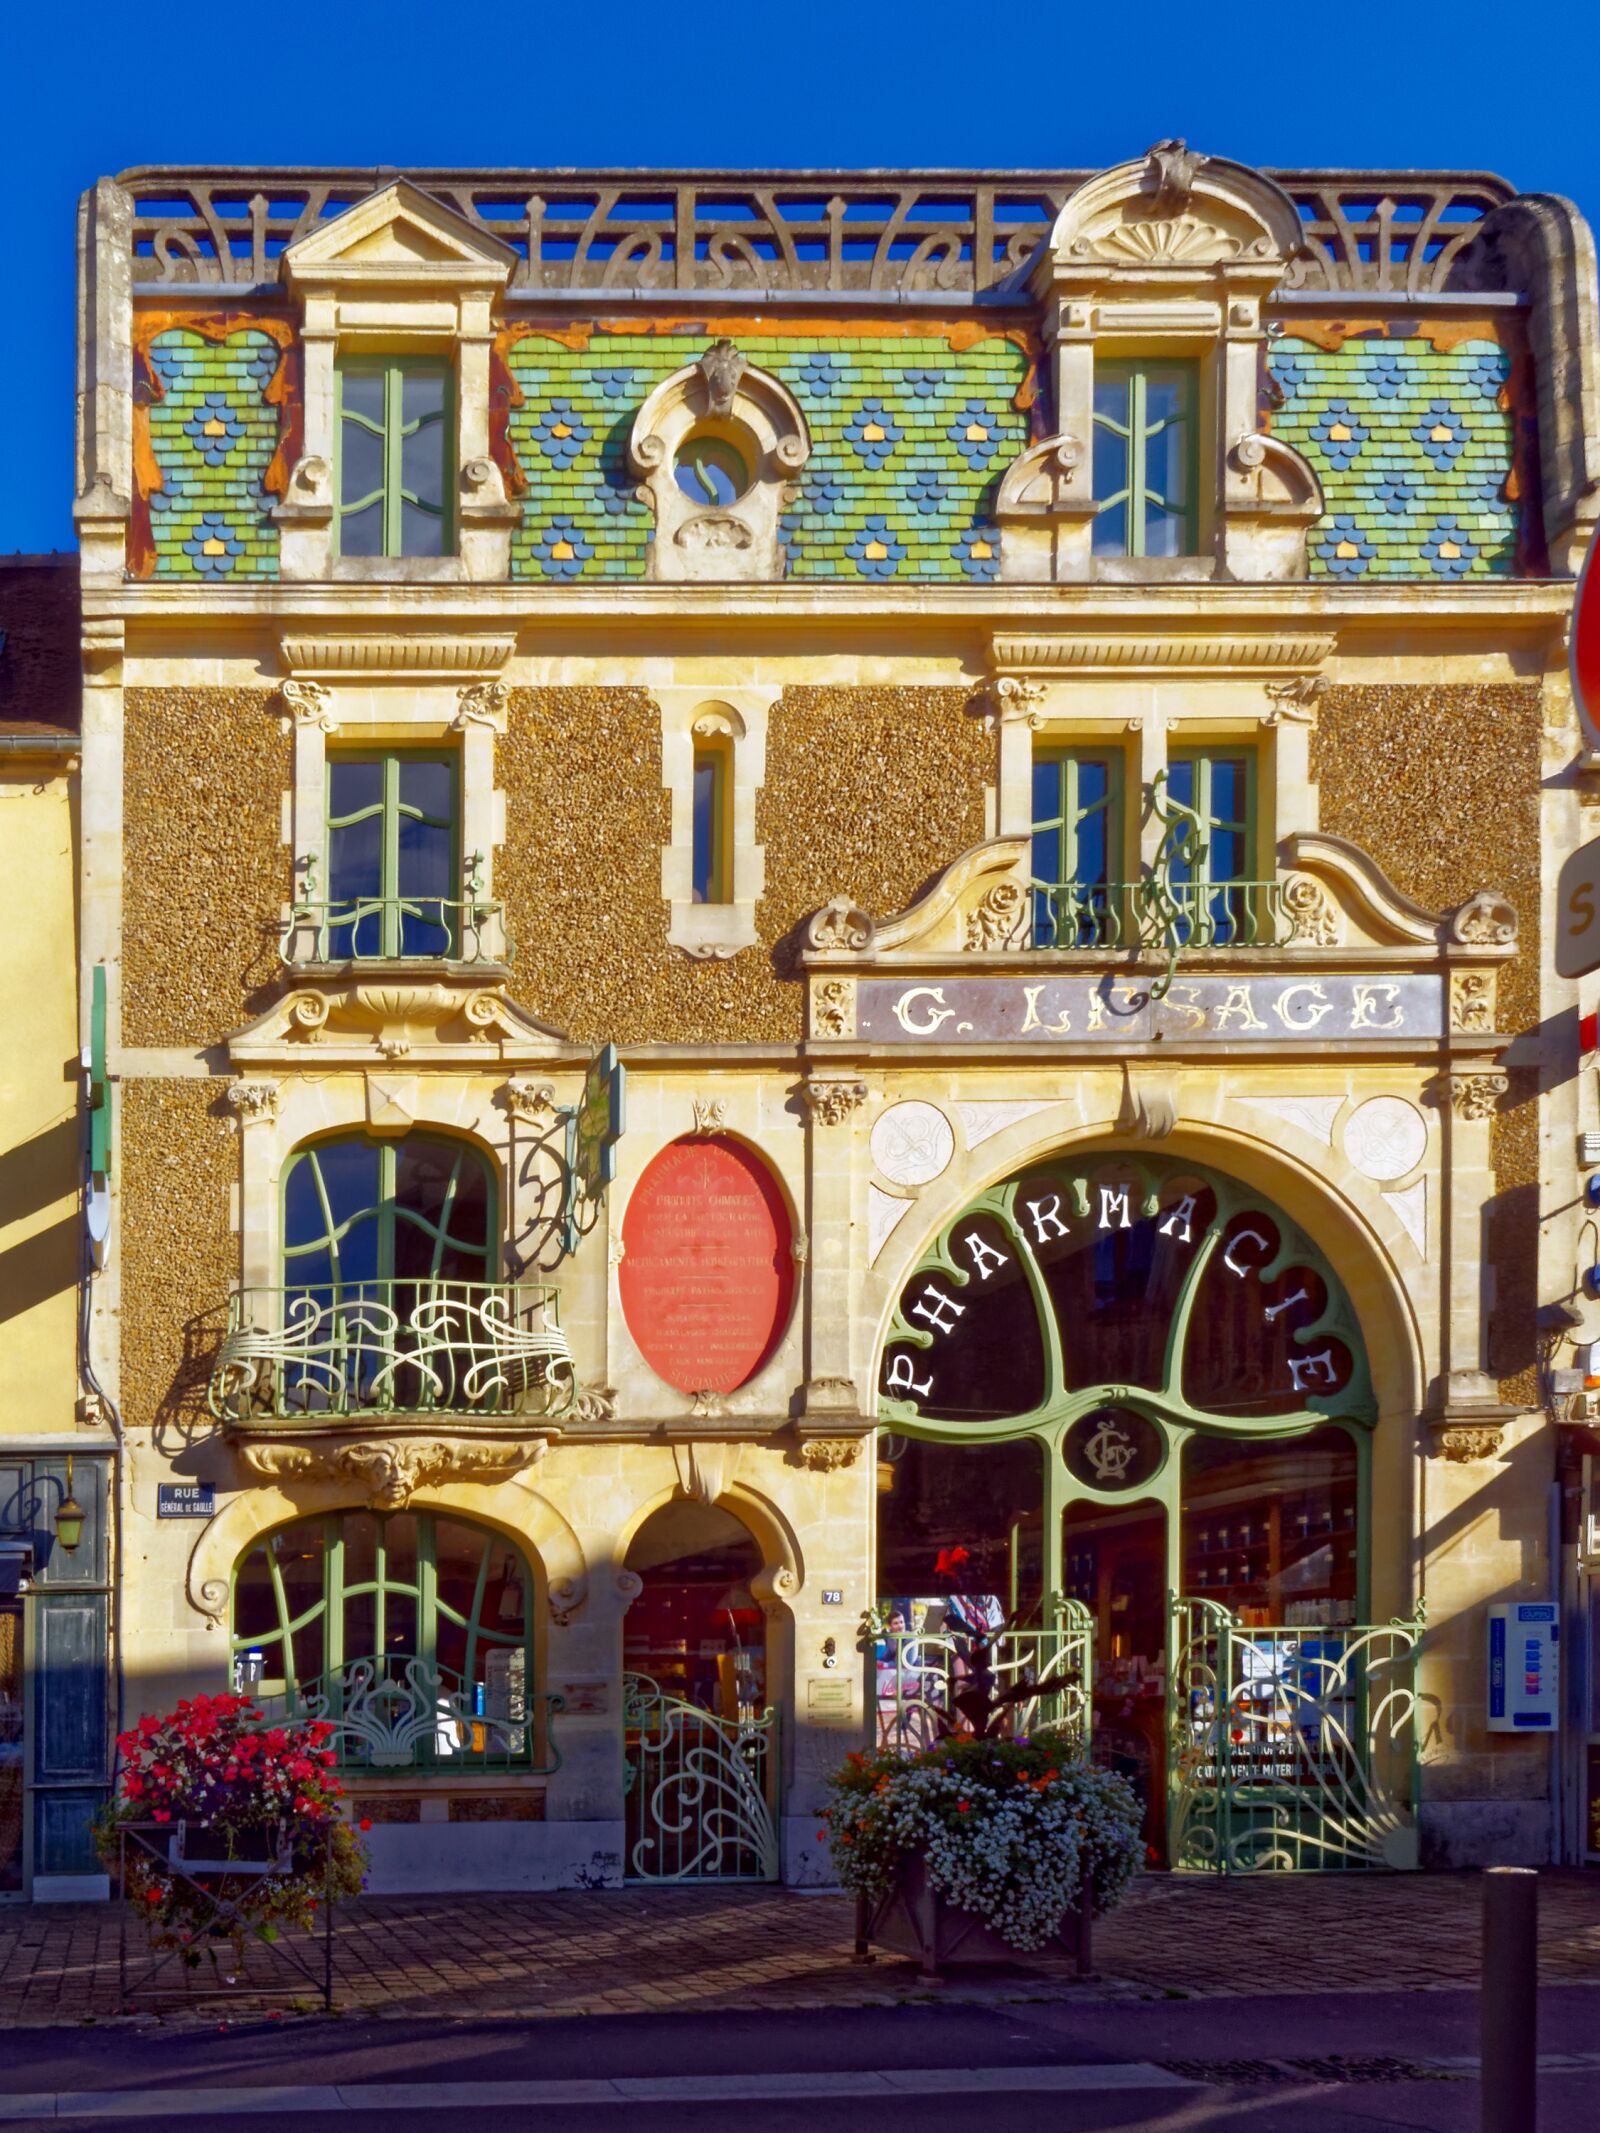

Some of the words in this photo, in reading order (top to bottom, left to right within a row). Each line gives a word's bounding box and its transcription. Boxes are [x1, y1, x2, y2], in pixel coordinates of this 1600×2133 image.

[891, 985, 974, 1036] G.
[1021, 984, 1406, 1035] LESAGE
[886, 1186, 1336, 1397] PHARMACIE
[174, 1487, 200, 1498] RUE
[161, 1501, 183, 1513] GÉNÉRAL
[193, 1502, 213, 1513] GAULLE
[825, 1592, 841, 1602] 78
